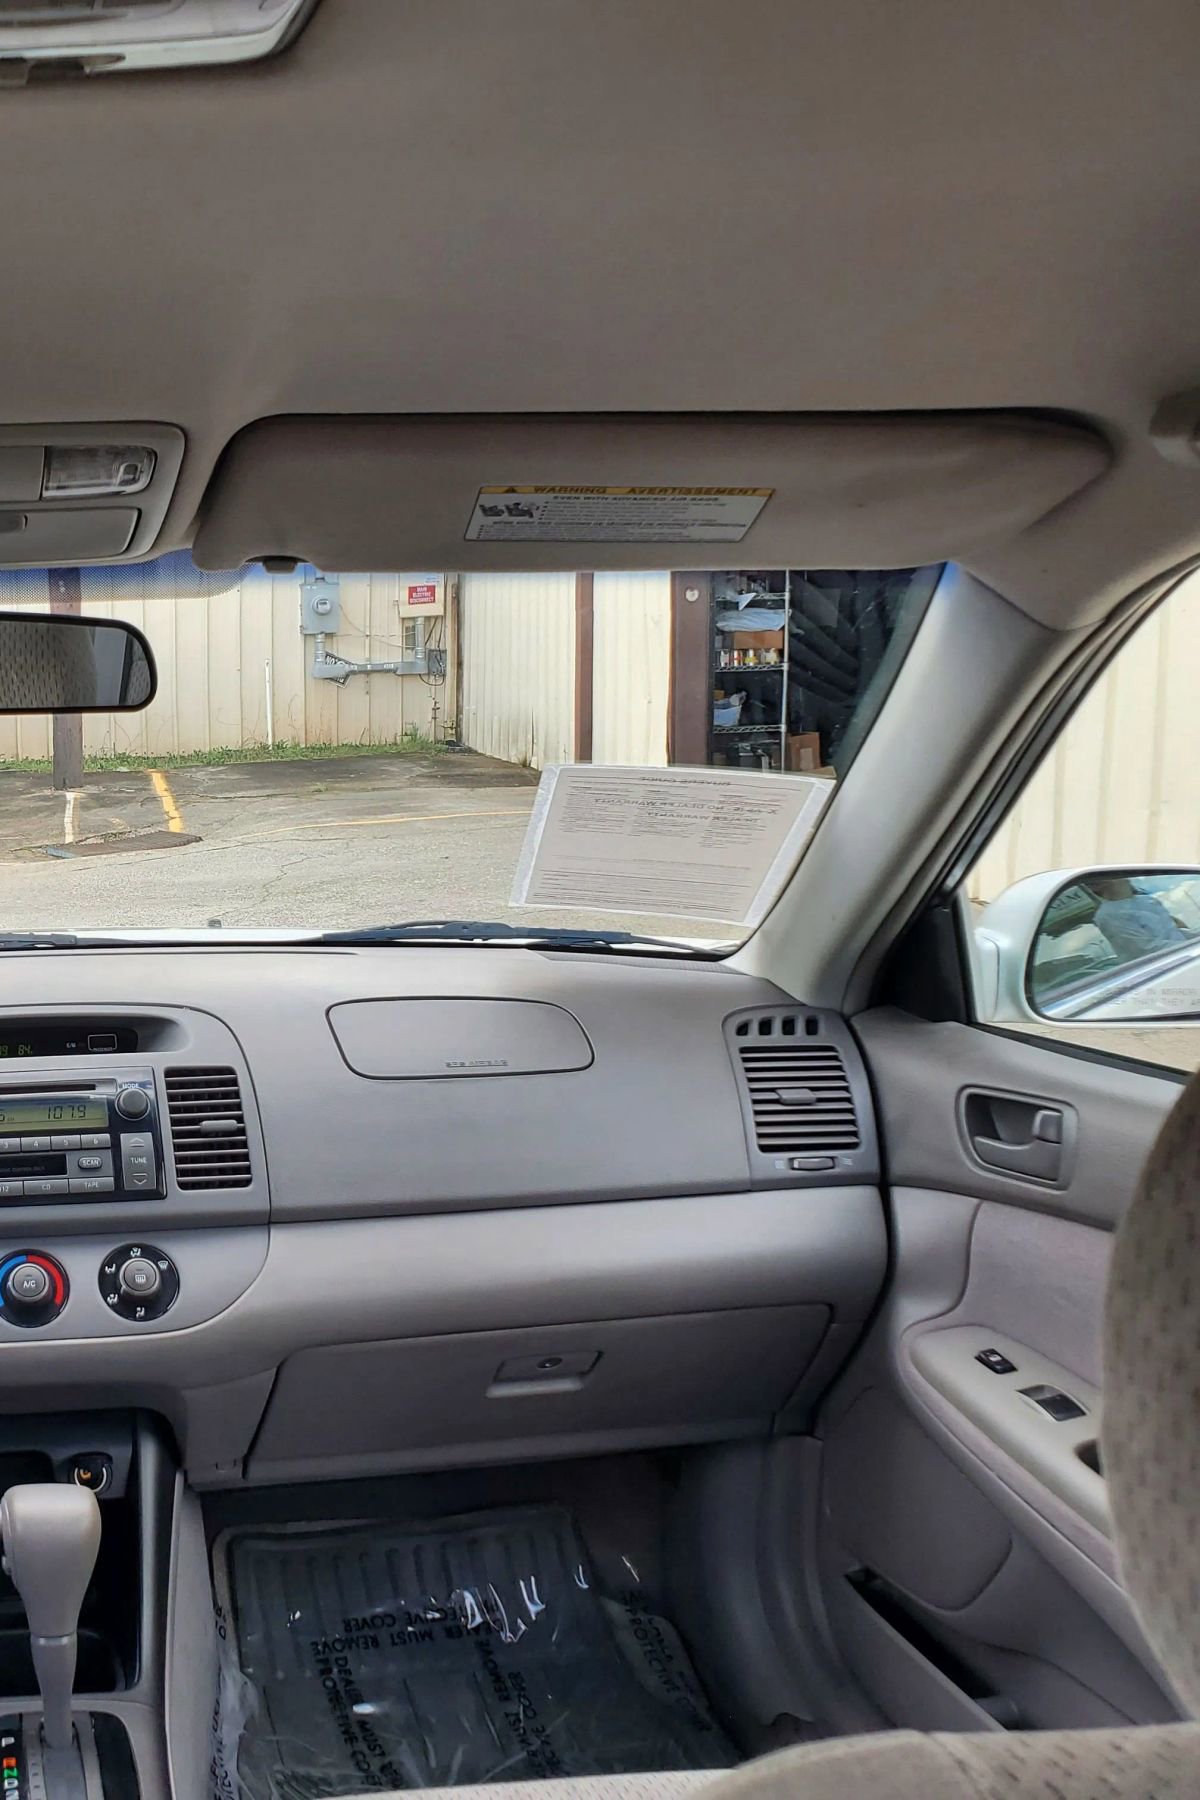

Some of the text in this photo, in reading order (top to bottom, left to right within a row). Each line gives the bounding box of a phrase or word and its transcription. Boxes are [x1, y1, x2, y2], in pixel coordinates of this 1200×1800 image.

[534, 487, 761, 496] WARNING AVERTISSEMENT
[47, 1104, 86, 1120] 107.9
[82, 1159, 99, 1167] SCAN
[41, 1183, 51, 1191] CD
[23, 1279, 36, 1289] A/C
[342, 1613, 397, 1633] COVER
[391, 1629, 434, 1647] MUST
[310, 1634, 380, 1656] REMOVE
[1, 1736, 15, 1747] P
[355, 1719, 387, 1758] MUST
[3, 1768, 18, 1778] N
[3, 1777, 19, 1790] D
